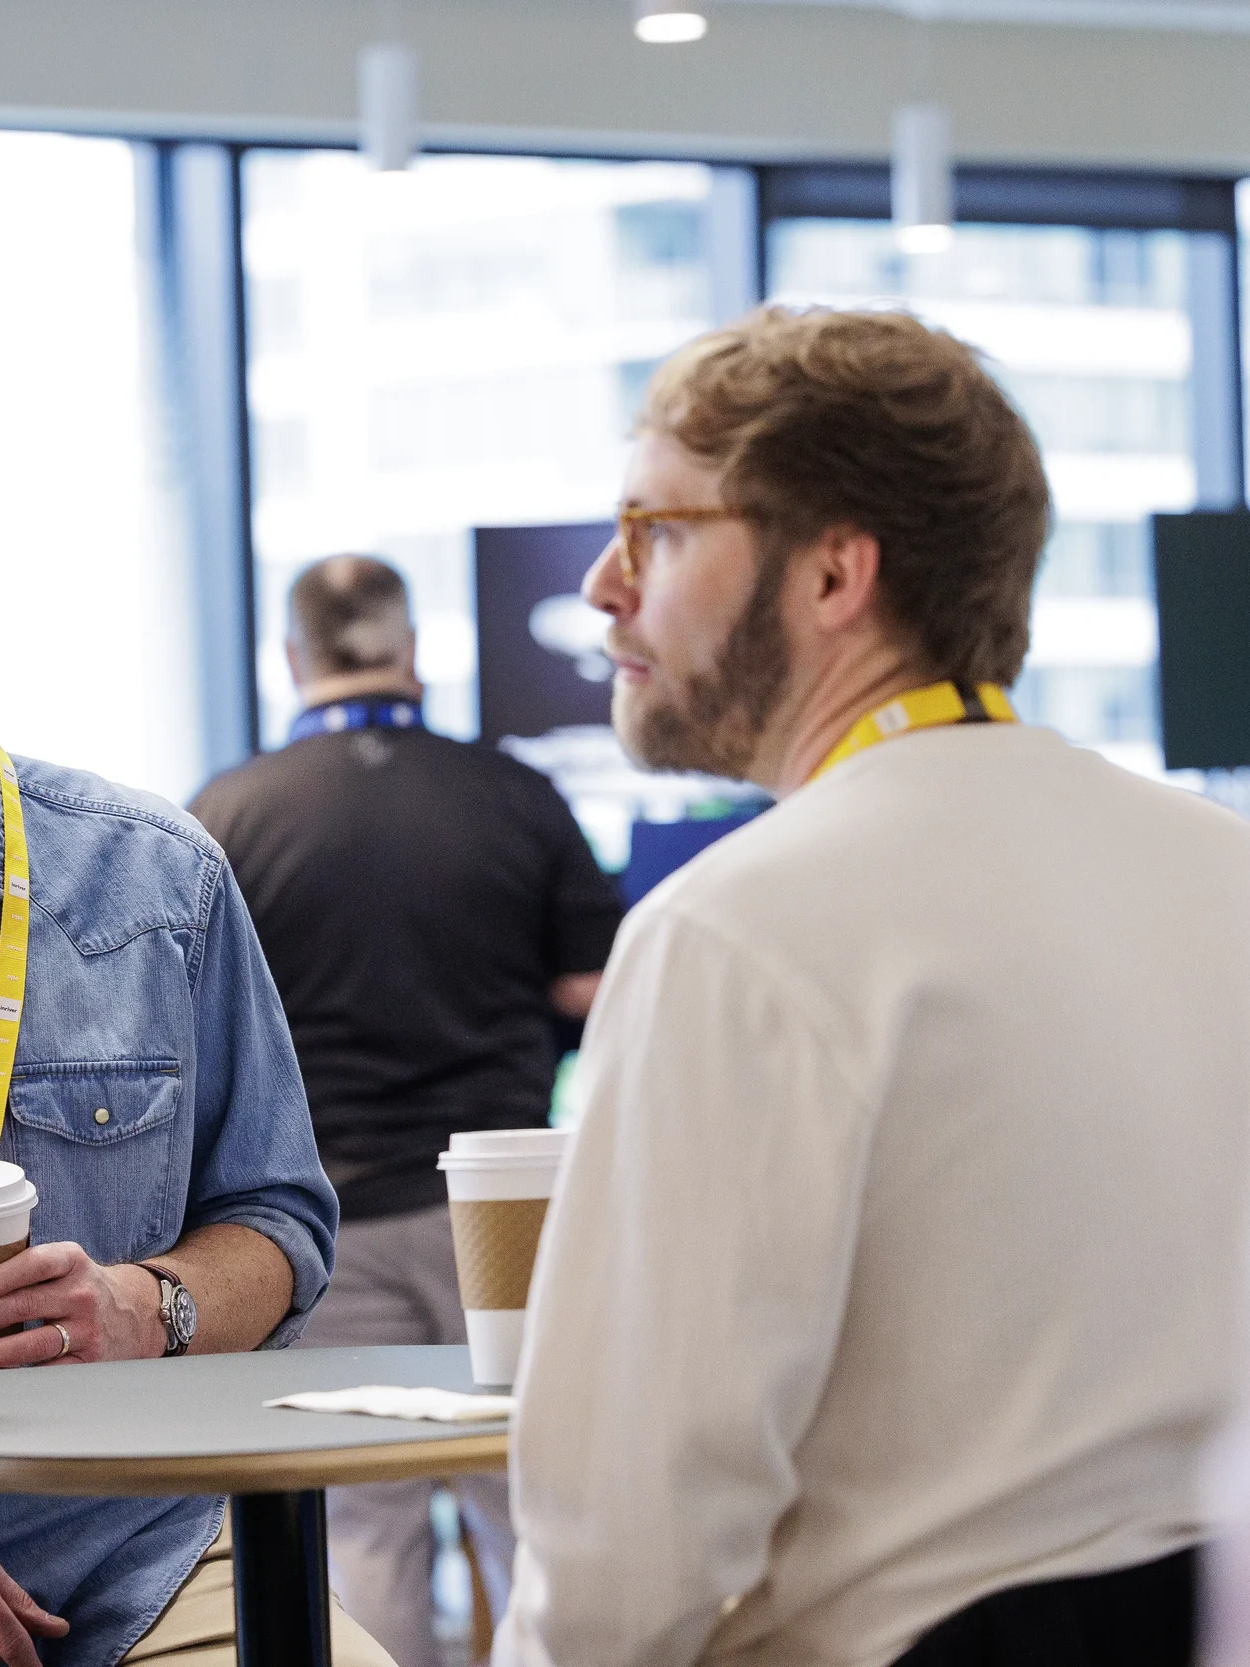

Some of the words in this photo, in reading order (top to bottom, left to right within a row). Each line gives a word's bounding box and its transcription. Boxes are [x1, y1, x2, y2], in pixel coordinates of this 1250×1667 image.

[12, 882, 26, 892] inriver
[7, 974, 18, 982] PIM
[0, 1005, 18, 1013] inriver
